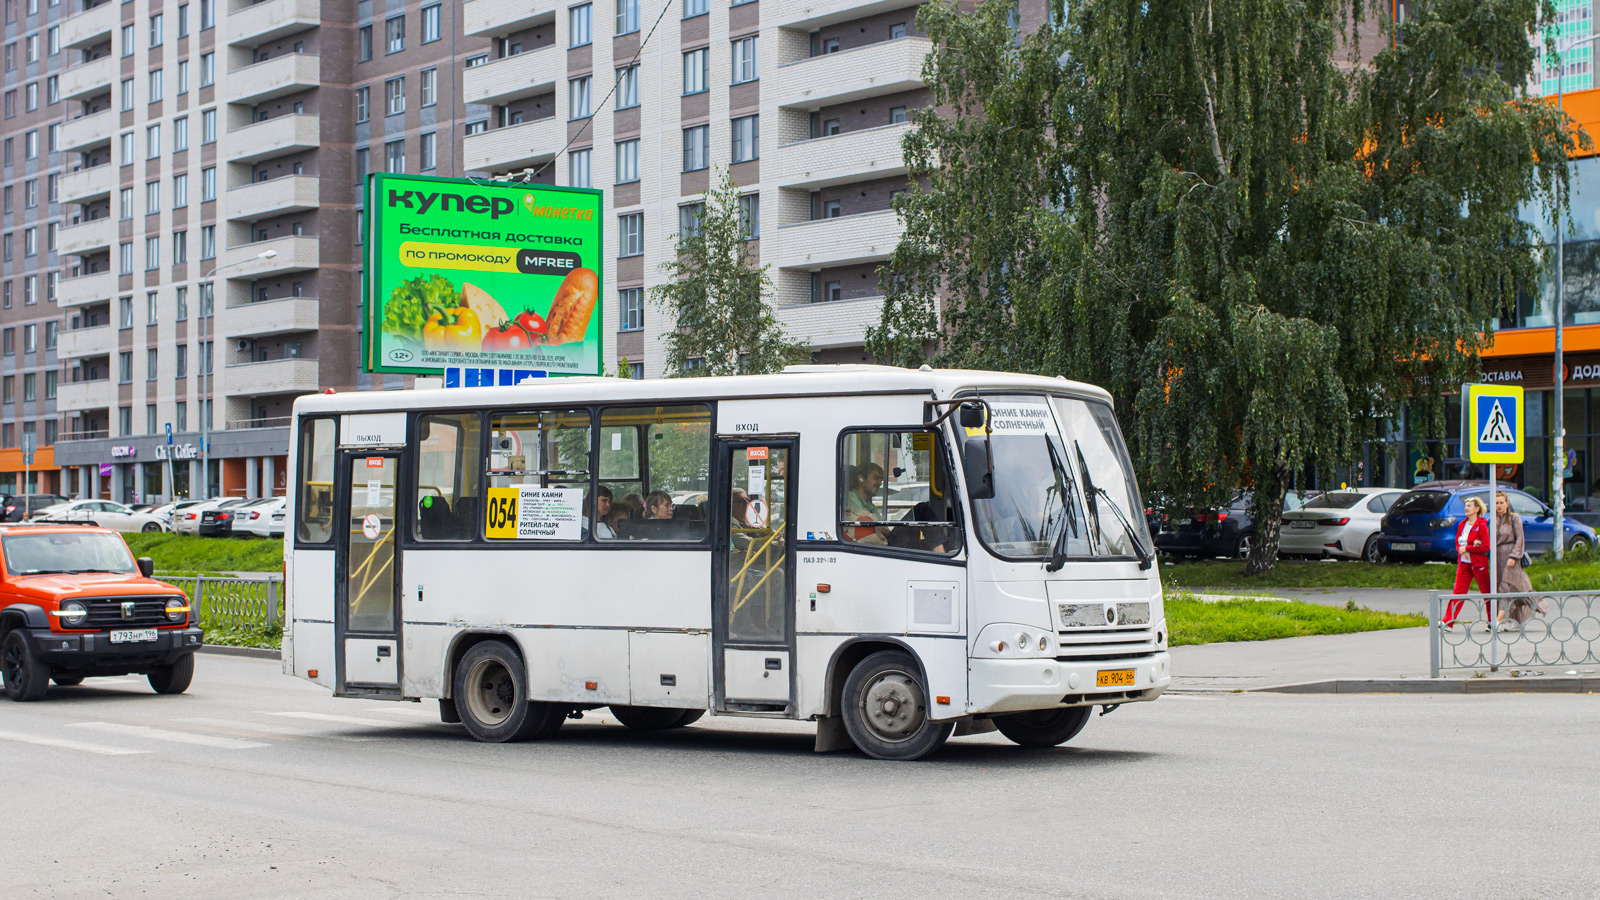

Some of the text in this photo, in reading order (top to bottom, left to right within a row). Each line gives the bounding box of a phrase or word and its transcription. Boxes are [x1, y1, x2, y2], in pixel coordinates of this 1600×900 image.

[388, 189, 514, 219] купер
[399, 223, 583, 246] Бесплатная доставка
[405, 250, 512, 265] ПО ПРОМОКОДУ
[525, 256, 574, 269] MFREE
[1480, 370, 1523, 383] ОСТАВКА
[990, 408, 1049, 418] СИНИЕ КАМНИ
[735, 423, 759, 432] ВХОД
[993, 418, 1046, 430] СОЛНЕЧНЫЙ
[356, 434, 381, 442] ВЫХОД
[175, 443, 197, 459] Coffee
[489, 497, 516, 528] 054
[145, 630, 156, 638] 196
[1111, 672, 1123, 684] 904
